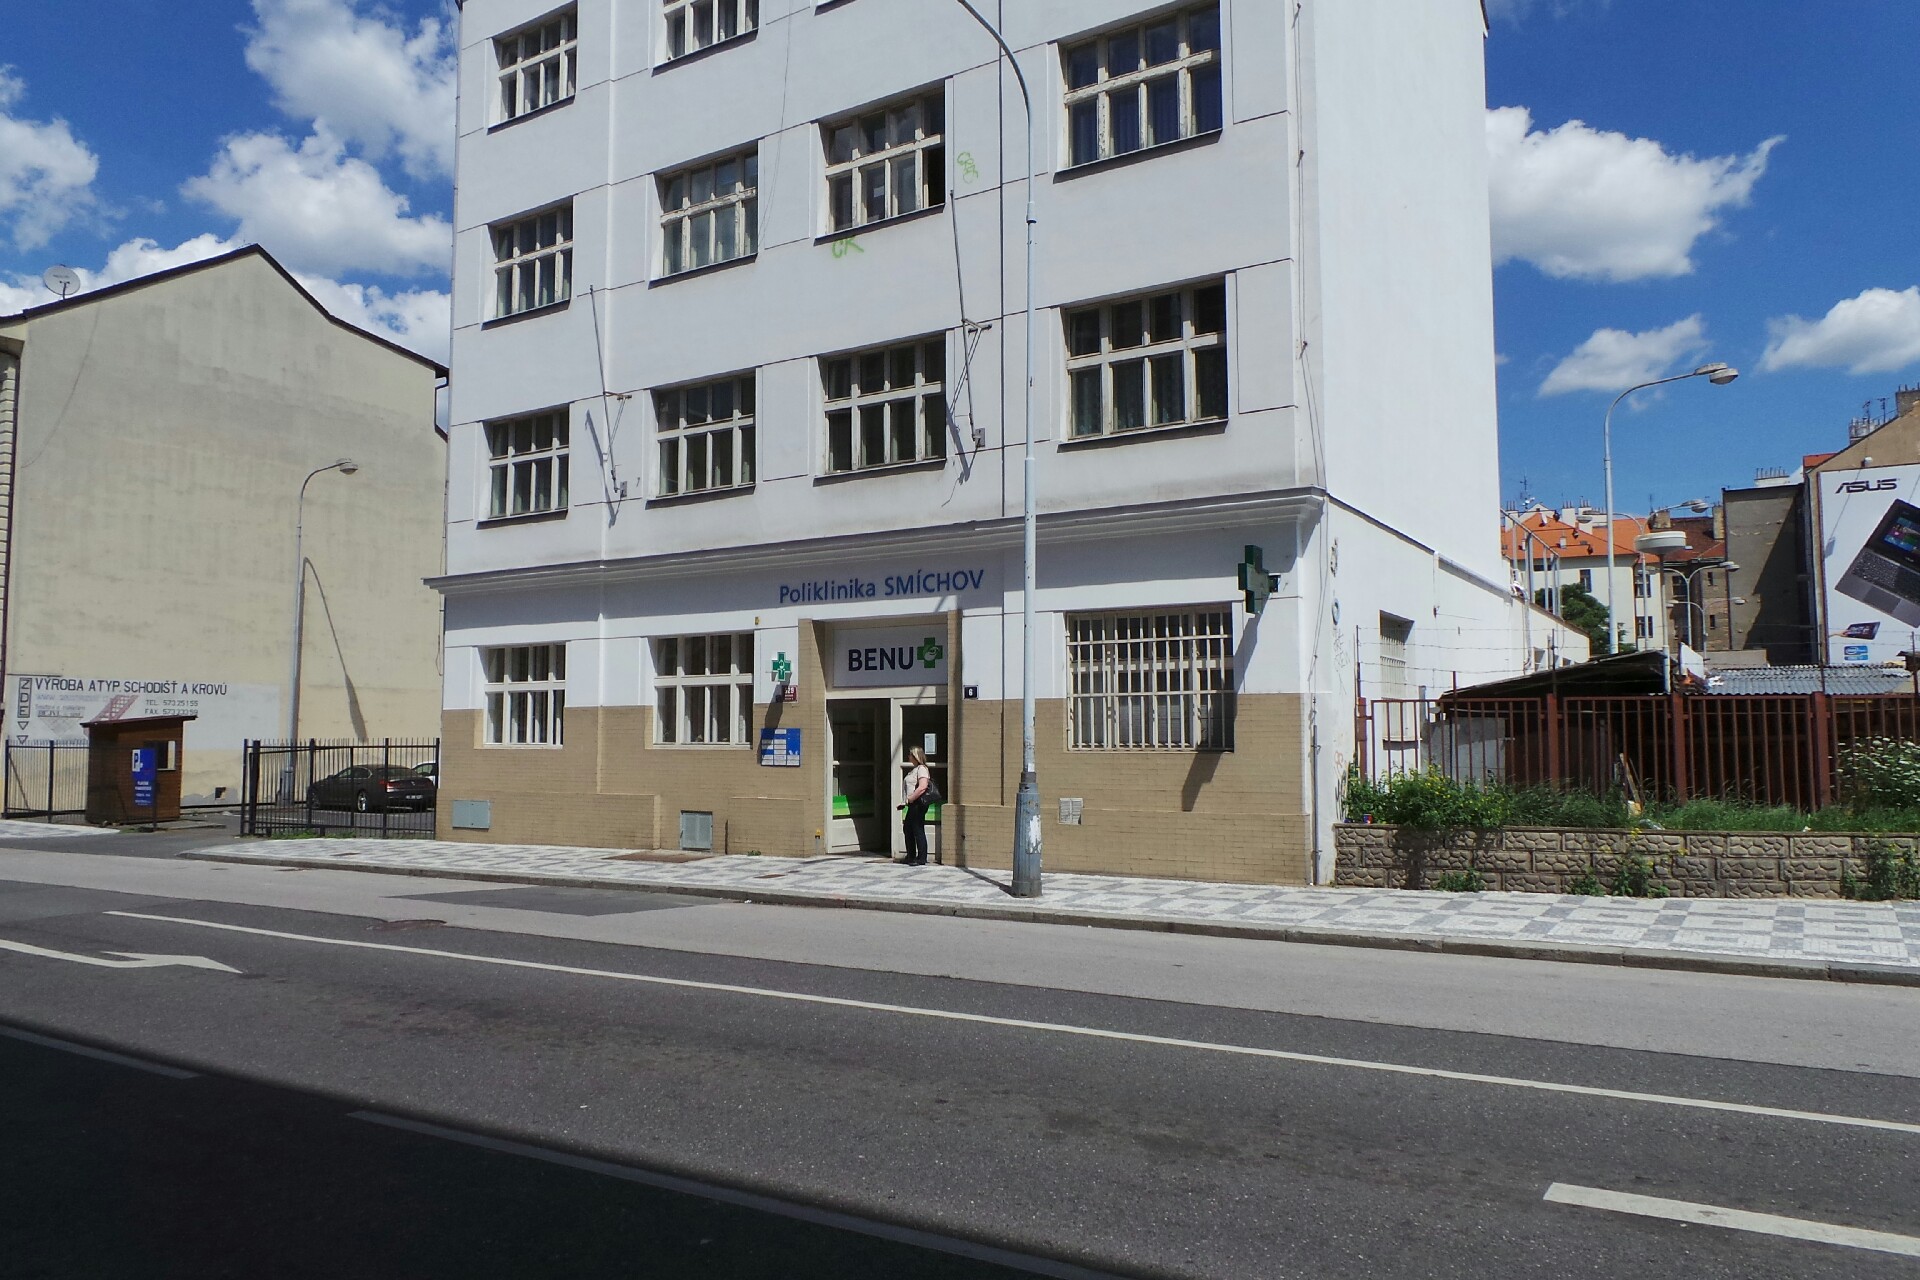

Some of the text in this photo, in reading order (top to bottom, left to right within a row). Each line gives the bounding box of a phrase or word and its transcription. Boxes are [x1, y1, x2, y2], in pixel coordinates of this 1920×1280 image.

[1835, 478, 1898, 494] ASUS
[779, 569, 984, 603] Poliklinika SMÍCHOV
[848, 646, 914, 672] BENU
[124, 680, 178, 694] SCHODIŠŤ
[181, 683, 188, 694] A
[968, 688, 973, 696] 6
[20, 680, 30, 716] ZDE
